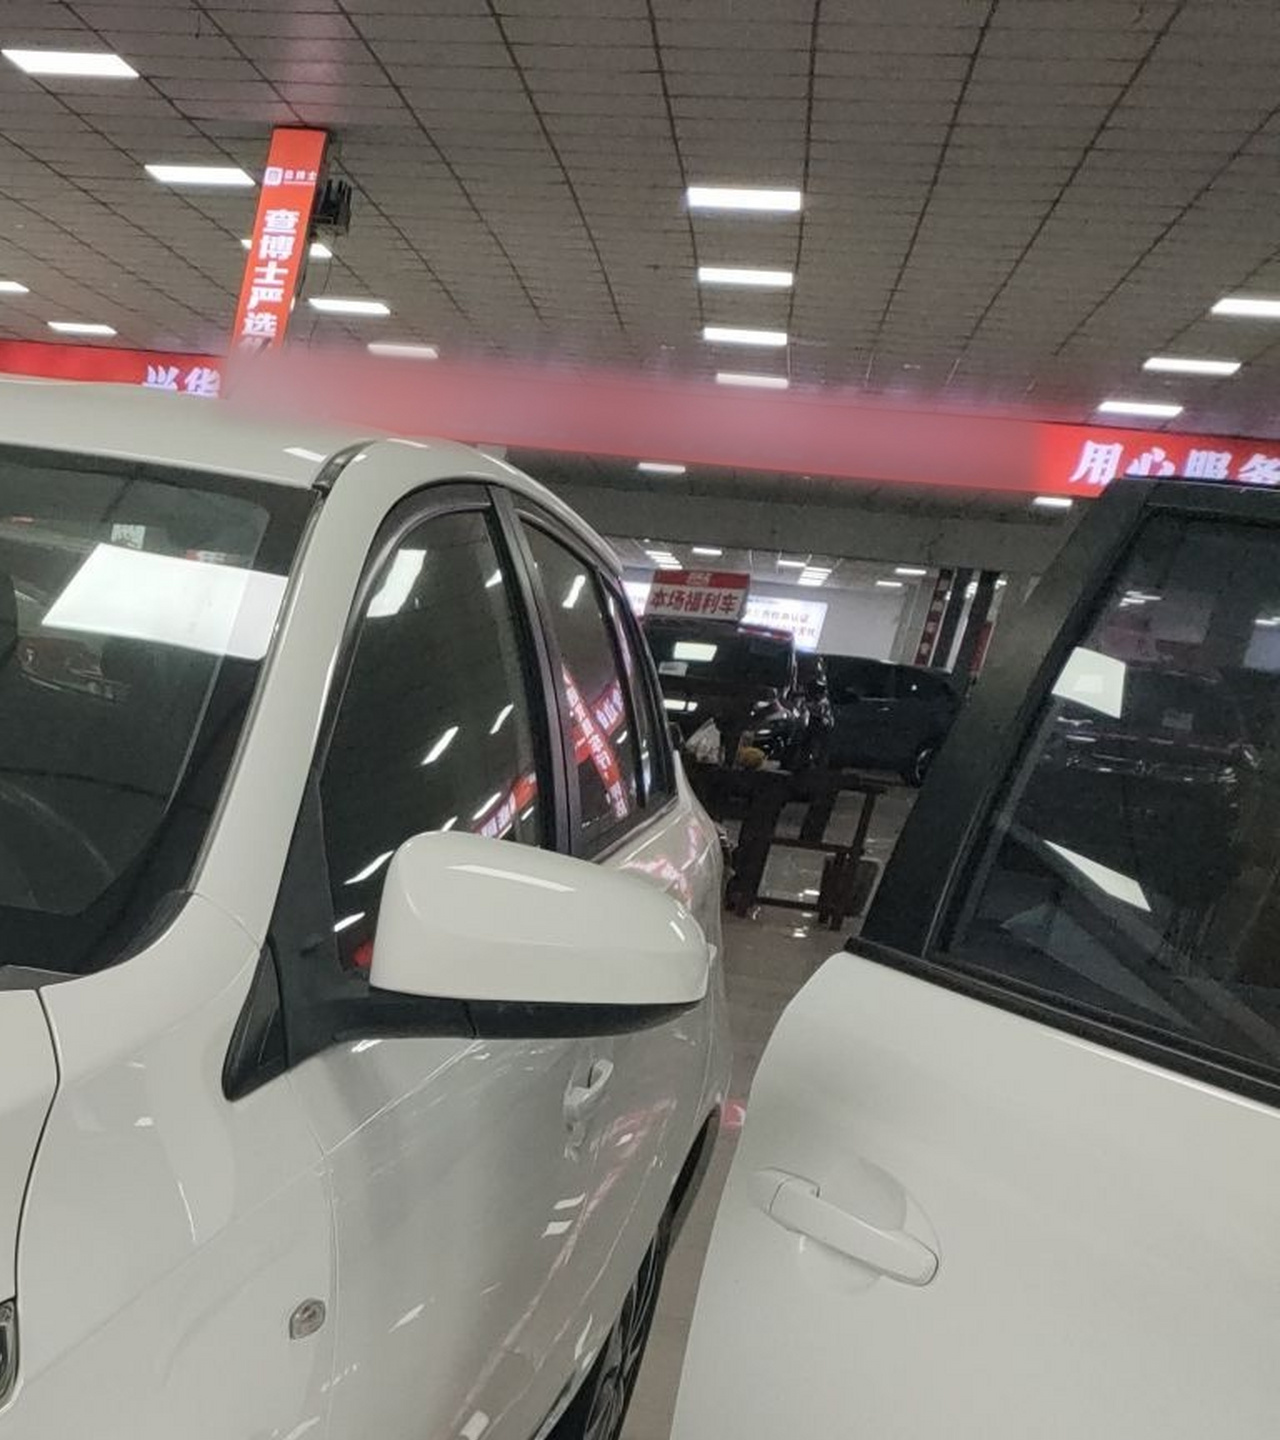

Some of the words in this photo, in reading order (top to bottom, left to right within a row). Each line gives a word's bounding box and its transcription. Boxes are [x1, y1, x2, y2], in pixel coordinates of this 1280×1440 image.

[652, 586, 738, 615] 本场福利车
